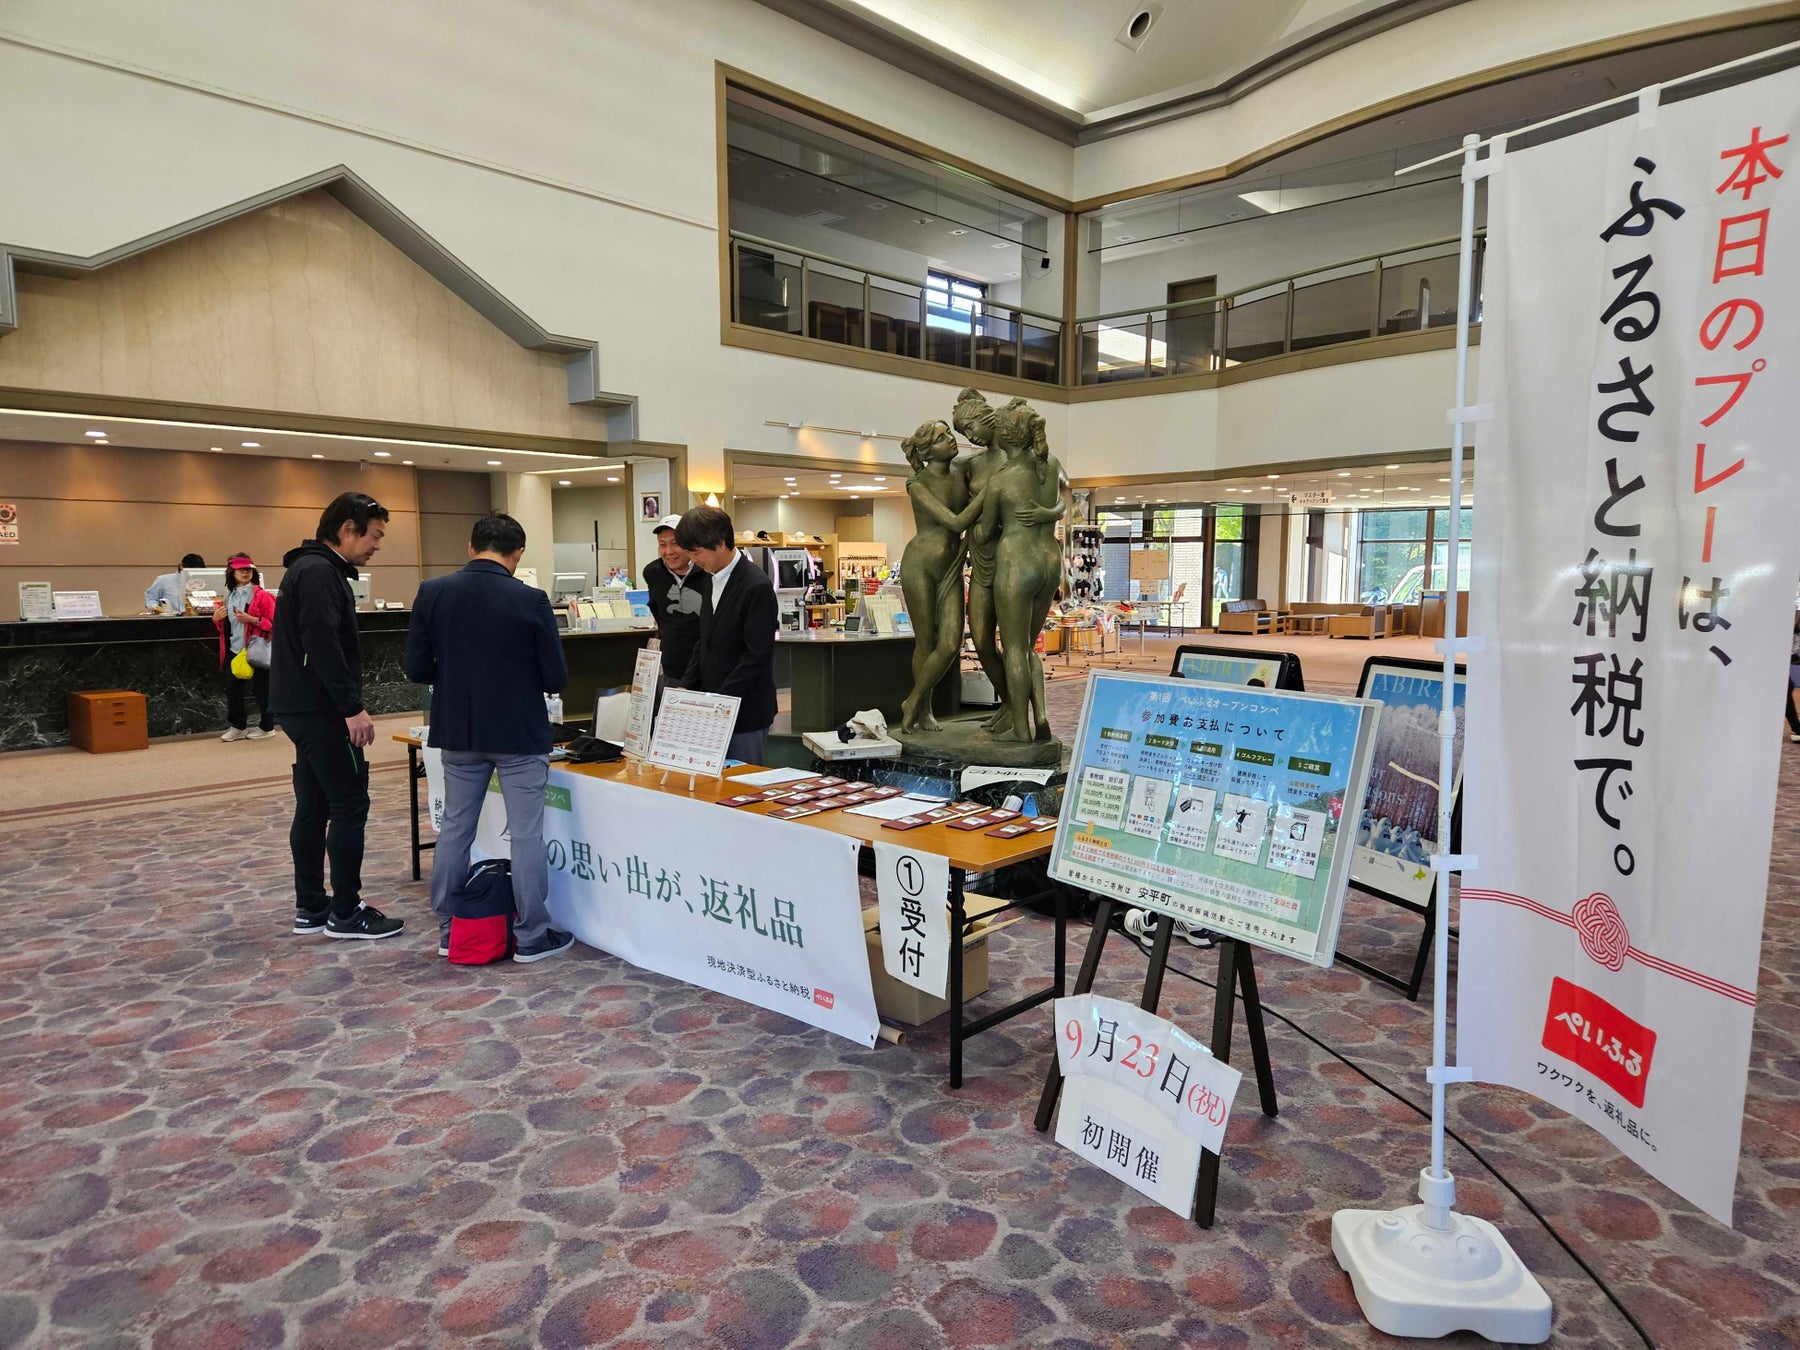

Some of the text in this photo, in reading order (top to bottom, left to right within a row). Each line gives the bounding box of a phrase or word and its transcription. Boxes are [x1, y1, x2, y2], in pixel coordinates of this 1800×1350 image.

[1677, 126, 1789, 666] 本日のプレーは、
[1571, 156, 1686, 876] ふるさと納税で。
[1141, 709, 1286, 741] 参加費お支払について
[1138, 886, 1172, 906] 安平町
[706, 955, 811, 1000] 現地決済型ふるさと納税
[1554, 1011, 1643, 1077] ぺいふる
[1537, 1061, 1658, 1152] ワクワクを、返礼品に。
[1081, 1114, 1162, 1185] 初開催
